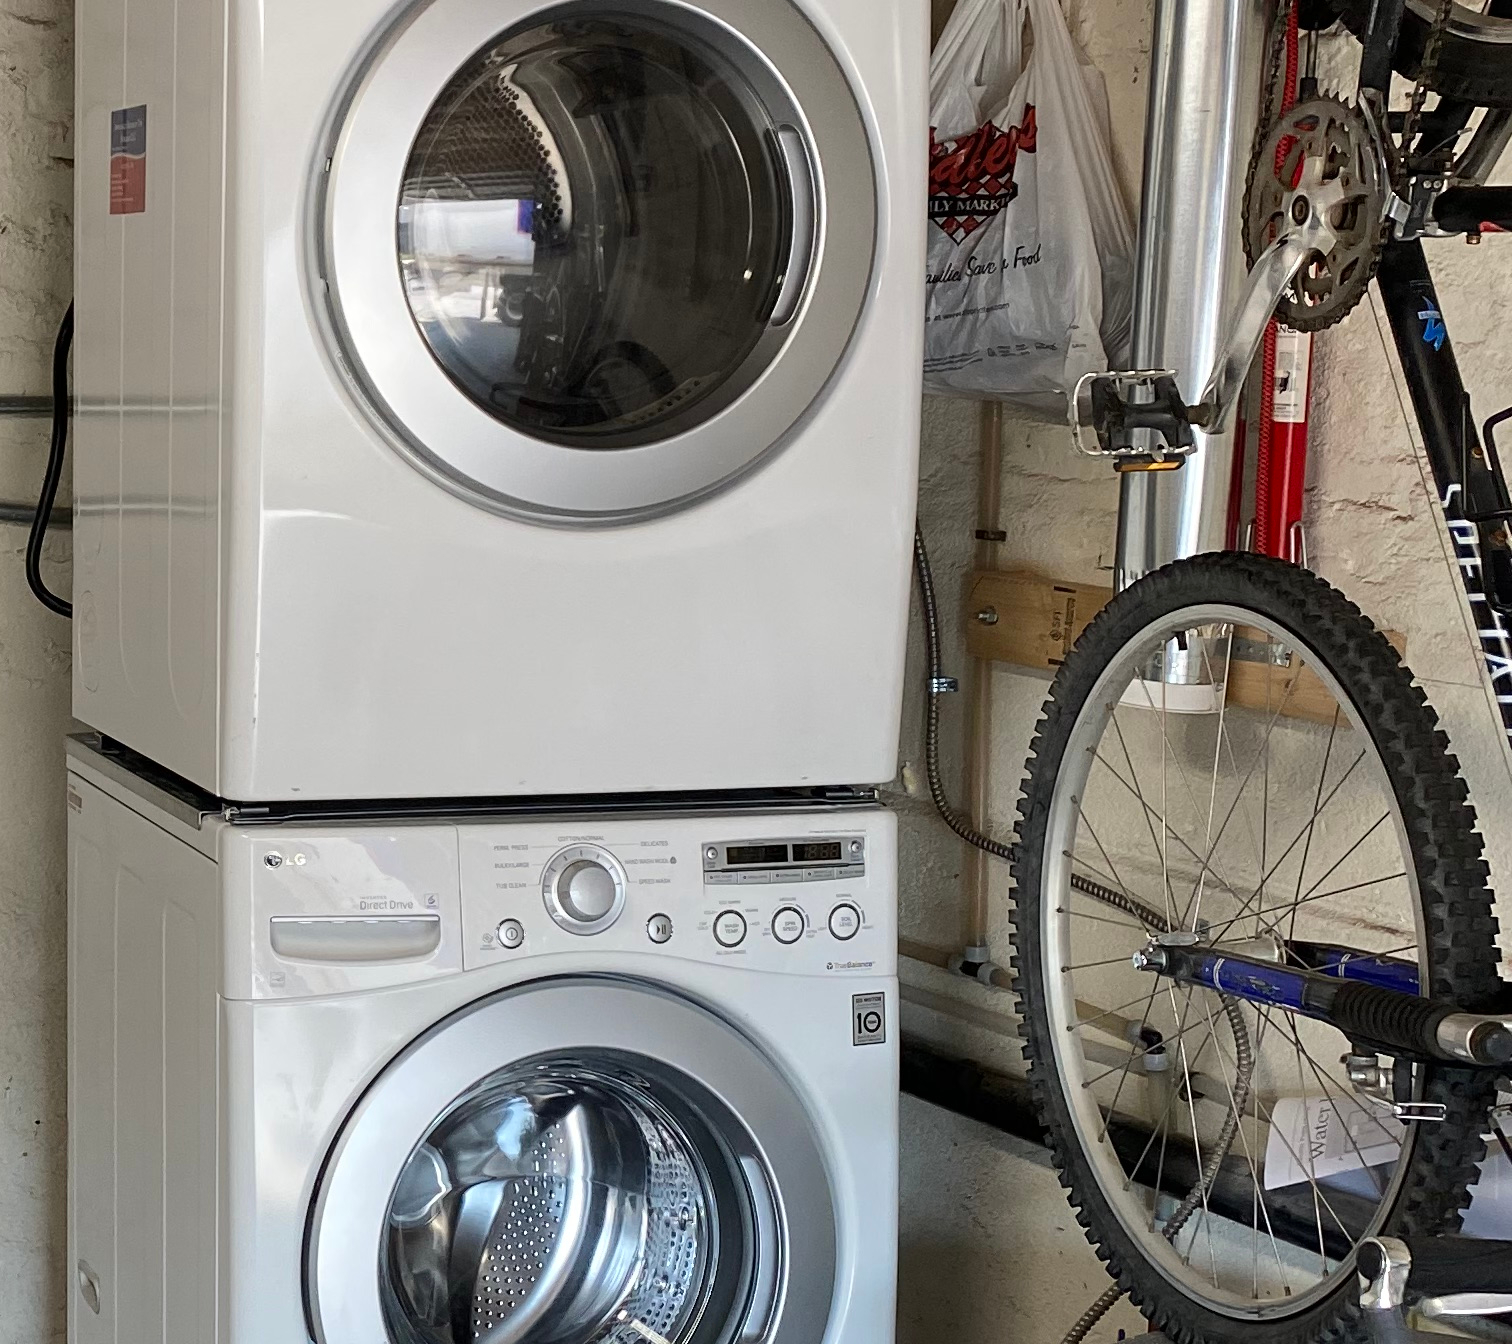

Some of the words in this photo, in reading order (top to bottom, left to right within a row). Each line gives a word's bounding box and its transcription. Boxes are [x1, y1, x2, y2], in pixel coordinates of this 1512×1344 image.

[285, 853, 307, 866] LG
[359, 900, 388, 911] Direct
[389, 899, 414, 910] Drive
[856, 1010, 882, 1035] 10
[1309, 1106, 1332, 1160] Water
